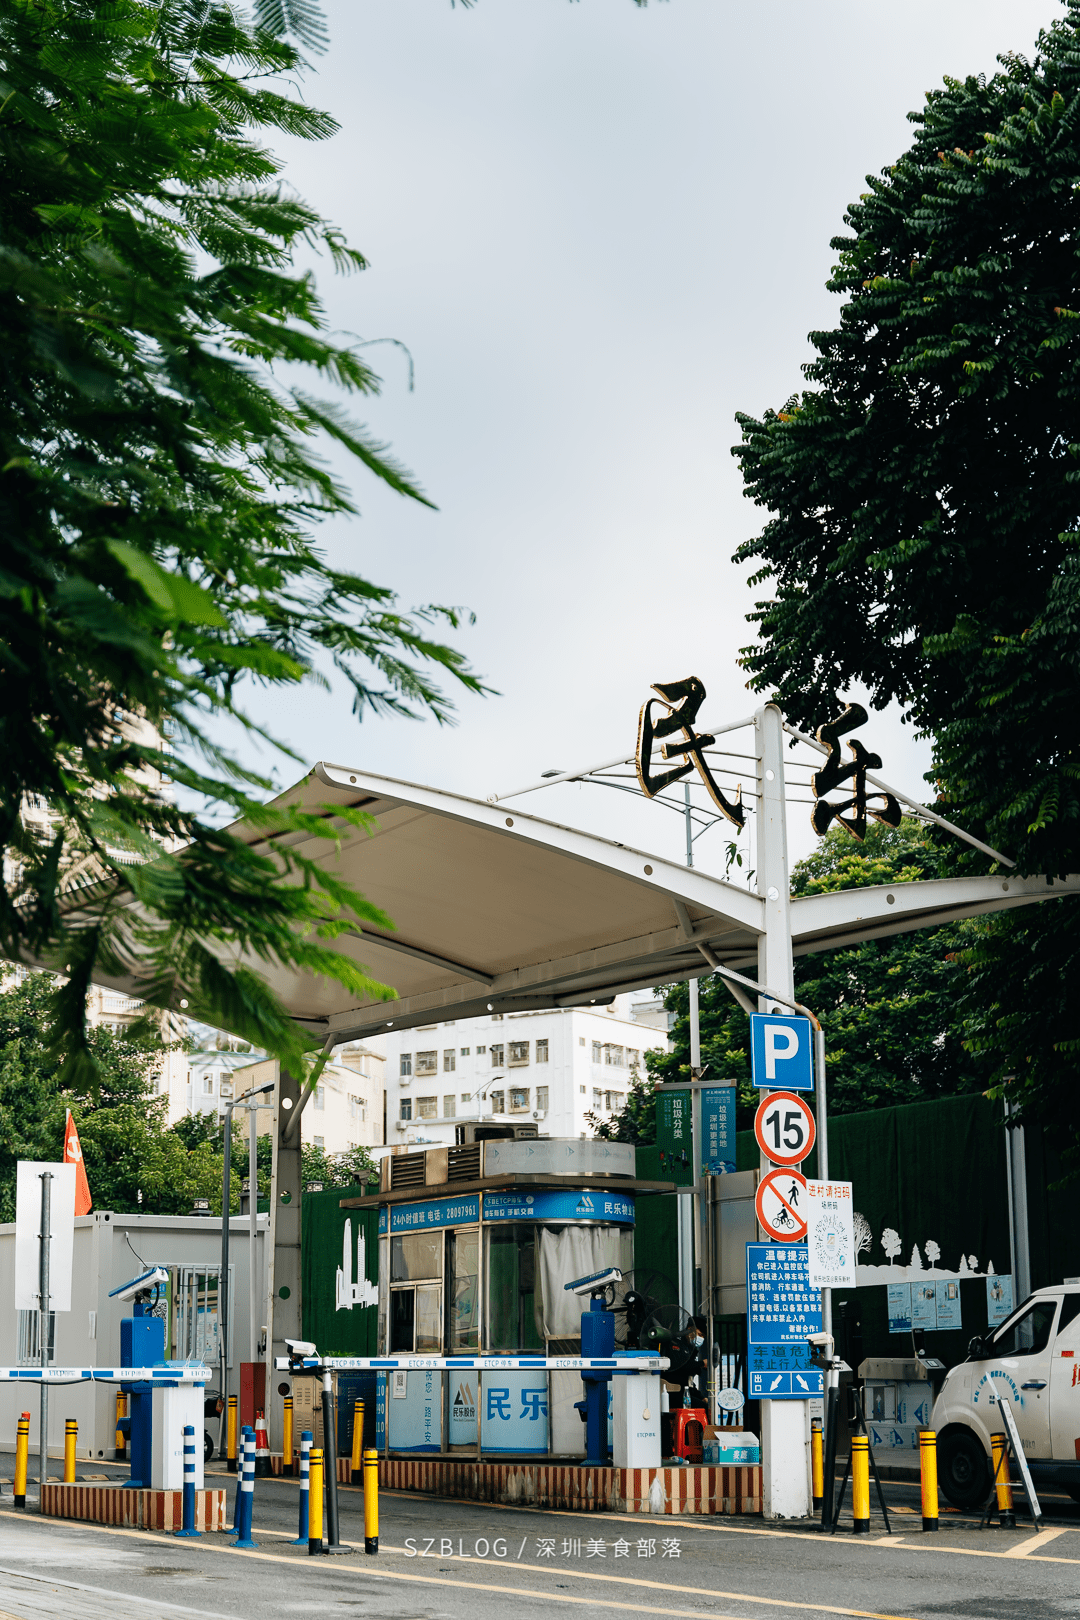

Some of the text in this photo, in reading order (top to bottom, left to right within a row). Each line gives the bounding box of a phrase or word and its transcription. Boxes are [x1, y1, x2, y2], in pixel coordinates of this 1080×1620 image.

[635, 675, 902, 843] 民乐
[764, 1024, 799, 1079] P
[673, 1099, 683, 1139] 垃圾分类
[719, 1105, 727, 1148] 垃圾不落地
[766, 1110, 804, 1150] 15
[709, 1114, 718, 1157] 深圳更美丽
[808, 1184, 850, 1199] 进村请扫码
[393, 1211, 425, 1226] 24小时值班
[446, 1204, 476, 1219] 28097961
[765, 1250, 809, 1262] 温馨提示
[752, 1314, 806, 1323] 共享单车禁止入内
[753, 1359, 821, 1370] 禁止行人通
[754, 1374, 762, 1391] 出口
[453, 1407, 475, 1418] 民乐股份
[487, 1388, 548, 1421] 民乐
